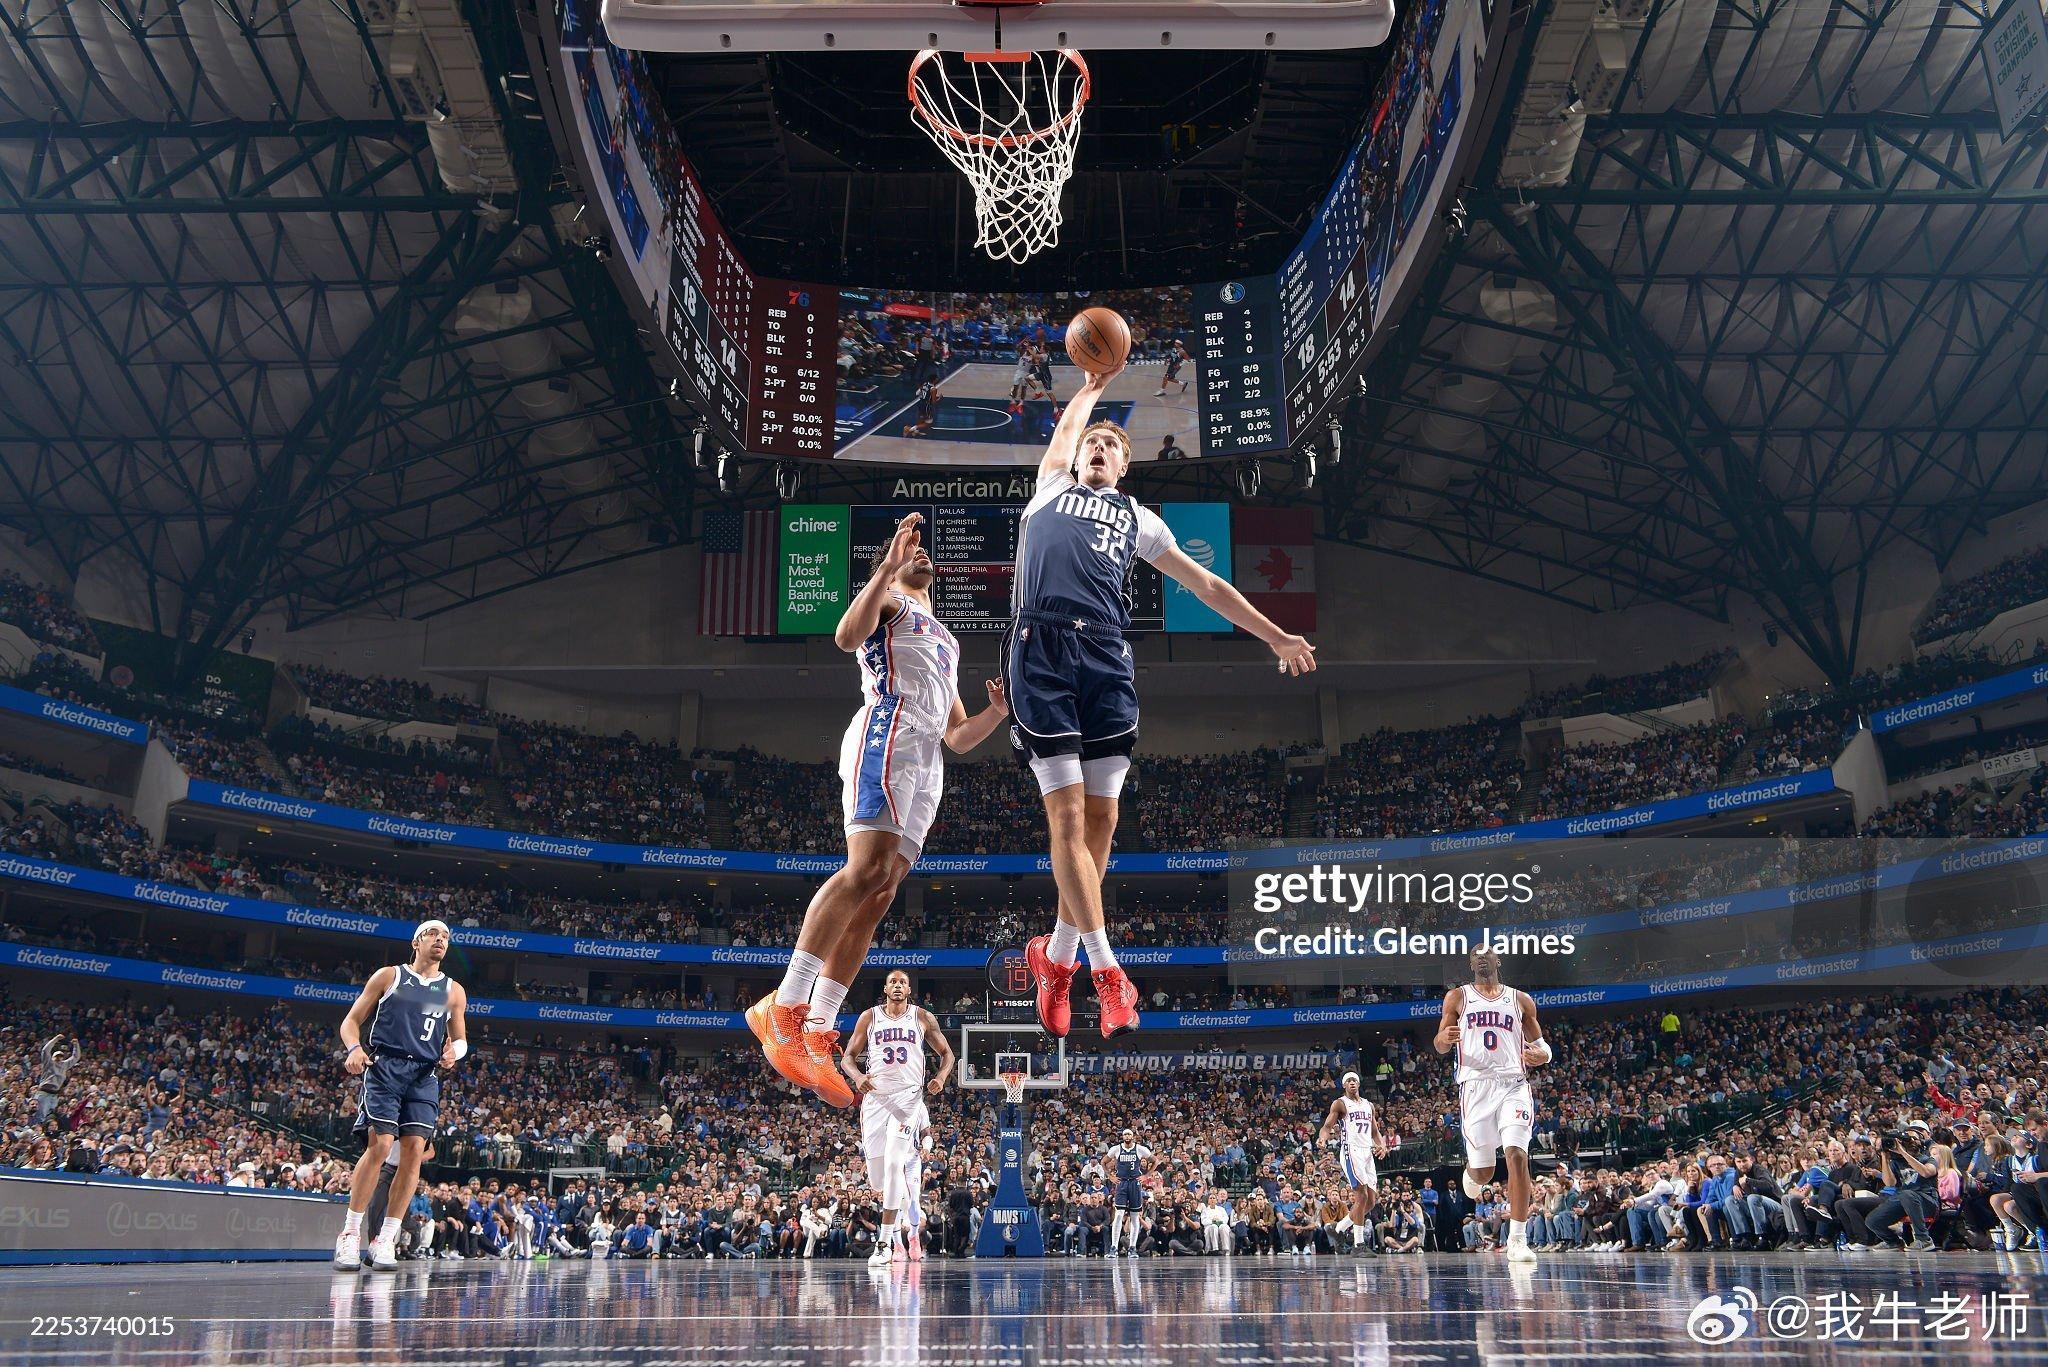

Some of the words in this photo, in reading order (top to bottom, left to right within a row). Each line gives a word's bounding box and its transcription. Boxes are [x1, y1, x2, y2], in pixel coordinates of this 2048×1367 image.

[1994, 10, 2028, 53] CENTRAL
[1999, 24, 2030, 66] DIVISION
[1997, 32, 2038, 86] CHAMPIONS
[683, 277, 696, 317] 18
[1340, 270, 1355, 312] 14
[674, 307, 682, 330] TOL
[768, 309, 786, 318] REB
[1205, 312, 1223, 321] REB
[768, 321, 780, 330] TO
[1347, 318, 1357, 336] TOL
[673, 331, 681, 351] FLS
[766, 334, 785, 343] BLK
[1206, 337, 1224, 346] BLK
[721, 339, 736, 376] 14
[766, 346, 782, 355] STL
[1206, 350, 1223, 359] STL
[1298, 334, 1315, 370] 18
[1349, 339, 1358, 359] FLS
[695, 339, 716, 385] 5:53
[1243, 364, 1259, 373] 8/9
[1318, 338, 1341, 383] 5:53
[765, 365, 778, 374] FG
[797, 368, 819, 378] 6/12
[764, 378, 786, 387] 3-PT
[800, 382, 816, 390] 2/5
[1209, 380, 1229, 389] 3-PT
[1244, 377, 1260, 386] 0/0
[723, 383, 733, 403] TOL
[764, 391, 775, 399] FT
[800, 394, 815, 403] 0/0
[1210, 394, 1220, 402] FT
[1245, 390, 1260, 398] 2/2
[1294, 391, 1304, 408] TOL
[722, 404, 731, 422] FLS
[763, 410, 775, 418] FG
[793, 414, 822, 423] 50.0%
[1211, 414, 1223, 422] FG
[1240, 408, 1270, 418] 88.9%
[1296, 411, 1306, 428] FLS
[762, 423, 783, 432] 3-PT
[792, 427, 822, 436] 40.0%
[1211, 426, 1232, 434] 3-PT
[1247, 421, 1271, 431] 0.0%
[762, 436, 773, 444] FT
[798, 440, 821, 449] 0.0%
[1212, 440, 1223, 448] FT
[1237, 434, 1272, 446] 100.0%
[892, 478, 1002, 498] American
[1056, 493, 1132, 534] MAVS
[789, 518, 838, 532] chime
[1091, 522, 1127, 566] 32
[789, 554, 812, 564] The
[815, 554, 829, 564] #1
[788, 566, 820, 576] Most
[789, 577, 824, 588] Loved
[788, 589, 838, 602] Banking
[206, 675, 221, 684] DO
[1885, 691, 1974, 727] ticketmaster
[42, 701, 134, 738] ticketmaster
[221, 790, 316, 819] ticketmaster
[1707, 783, 1801, 809] ticketmaster
[368, 817, 456, 842] ticketmaster
[1567, 810, 1654, 835] ticketmaster
[508, 836, 592, 858] ticketmaster
[1430, 831, 1515, 852] ticketmaster
[642, 850, 727, 868] ticketmaster
[1166, 856, 1248, 869] ticketmaster
[1297, 847, 1380, 863] ticketmaster
[1941, 840, 2044, 873] ticketmaster
[1788, 873, 1882, 904] ticketmaster
[134, 883, 229, 913] ticketmaster
[286, 909, 379, 933] ticketmaster
[1639, 901, 1731, 925] ticketmaster
[574, 941, 661, 958] ticketmaster
[1910, 936, 2004, 960] ticketmaster
[16, 949, 111, 973] ticketmaster
[1776, 956, 1860, 979] ticketmaster
[162, 968, 245, 990] ticketmaster
[1008, 970, 1026, 990] 19
[1649, 975, 1727, 995] ticketmaster
[538, 1006, 613, 1021] ticketmaster
[655, 1013, 729, 1026] ticketmaster
[1179, 1014, 1251, 1026] ticketmaster
[1293, 1009, 1366, 1023] ticketmaster
[1466, 1011, 1514, 1032] PHILA
[420, 1018, 436, 1042] 9
[874, 1027, 916, 1045] PHILA
[1483, 1030, 1497, 1051] 0
[883, 1047, 908, 1064] 33
[1183, 1055, 1247, 1071] PROUD
[1253, 1055, 1266, 1070] &
[1272, 1054, 1327, 1070] LOUD!
[1515, 1110, 1529, 1120] 76
[1356, 1123, 1369, 1134] 77
[1131, 1162, 1135, 1170] 3
[134, 1214, 198, 1231] LEXUS
[247, 1217, 296, 1233] LEXUS
